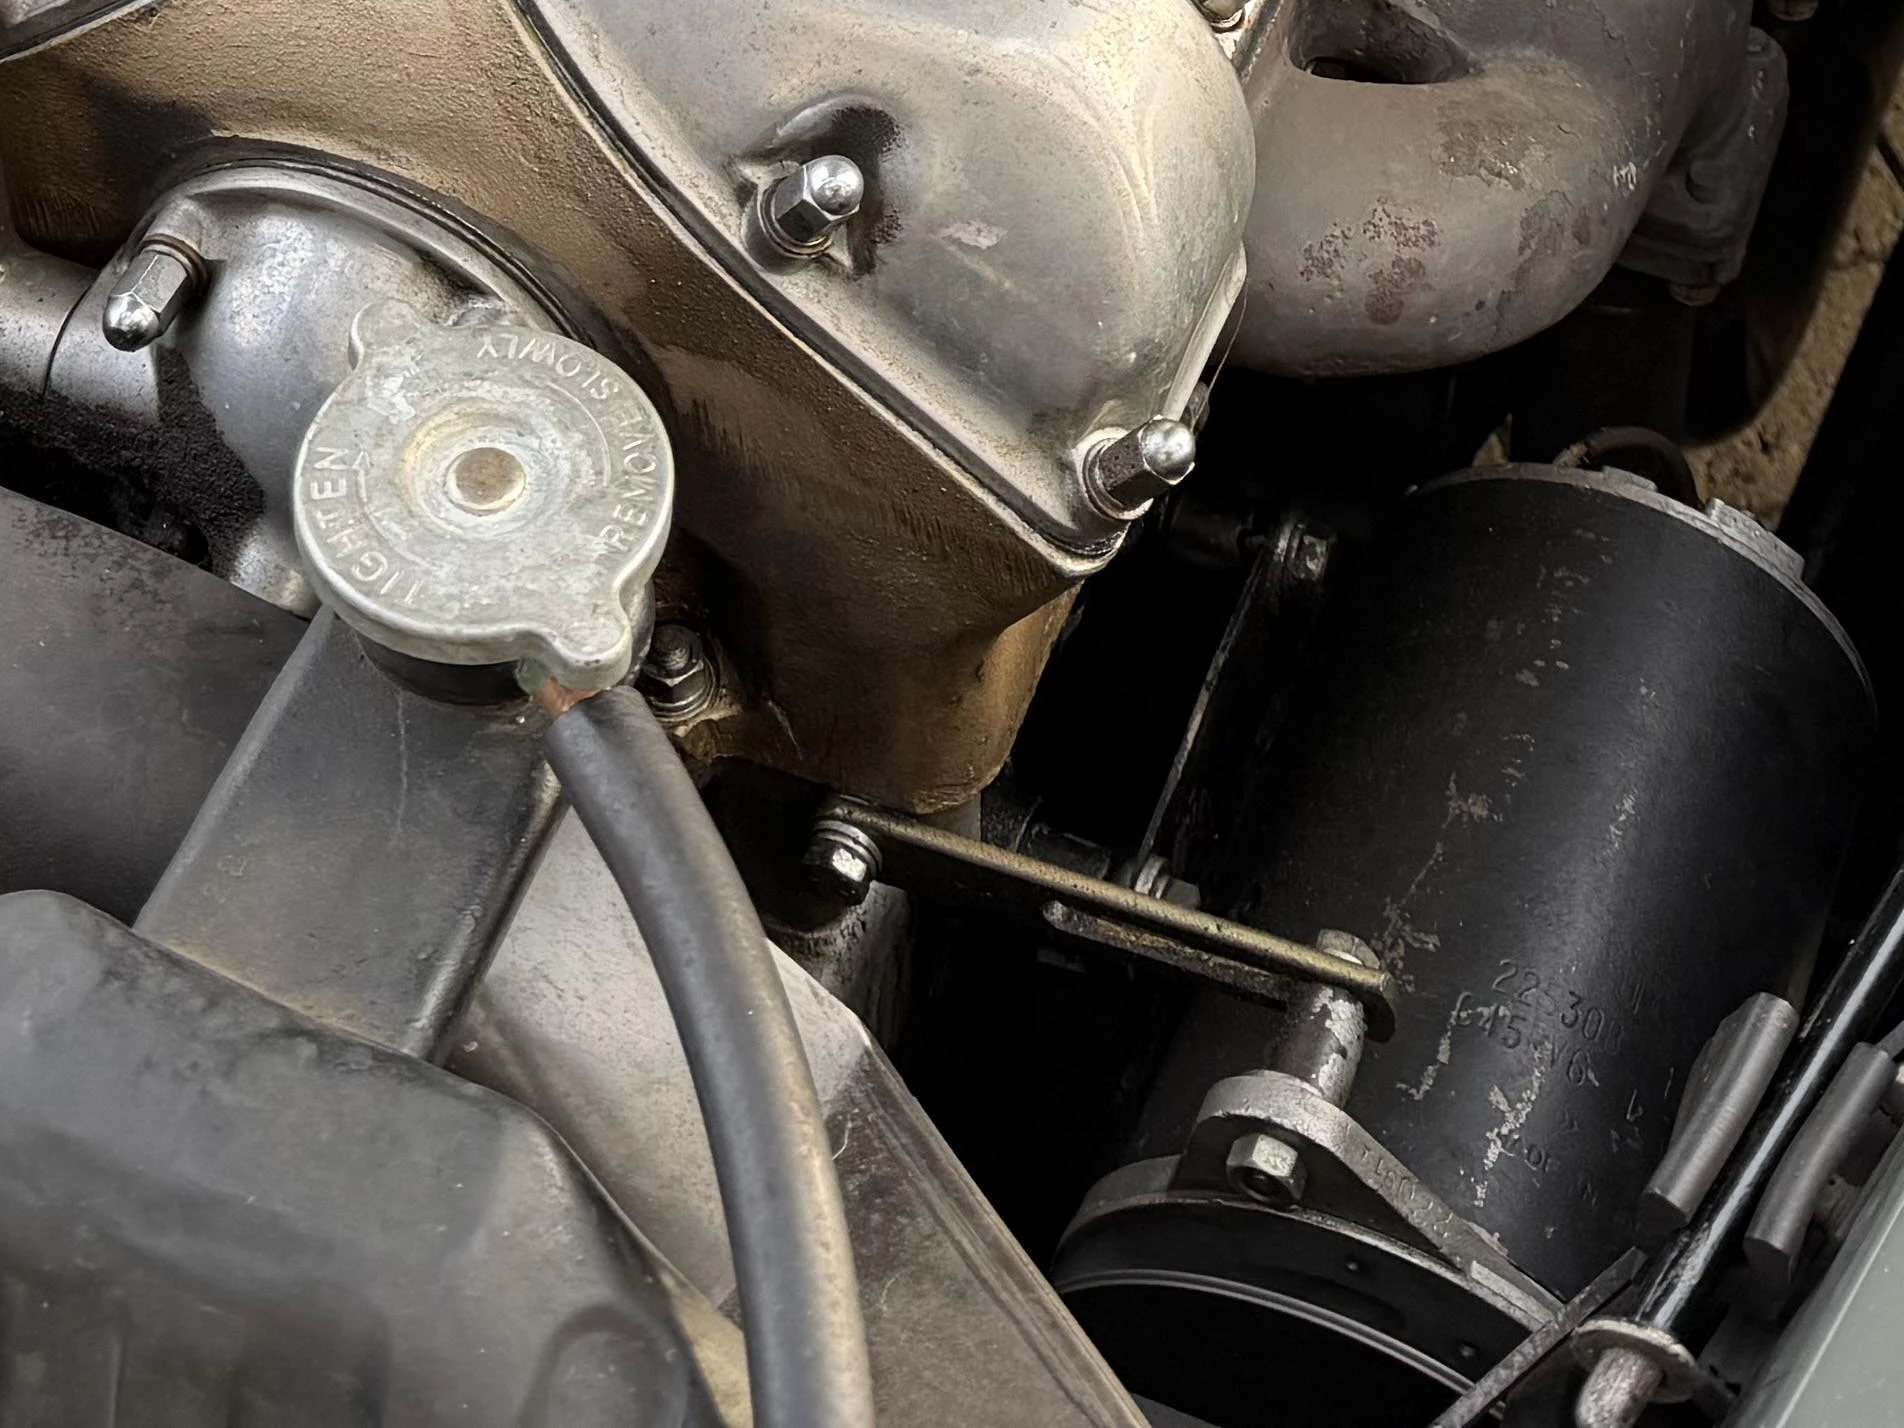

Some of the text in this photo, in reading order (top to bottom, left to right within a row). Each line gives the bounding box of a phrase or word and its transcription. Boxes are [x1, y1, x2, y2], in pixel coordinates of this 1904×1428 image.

[310, 446, 424, 604] TIGHTEN
[476, 332, 657, 552] REMOVE SLOWLY
